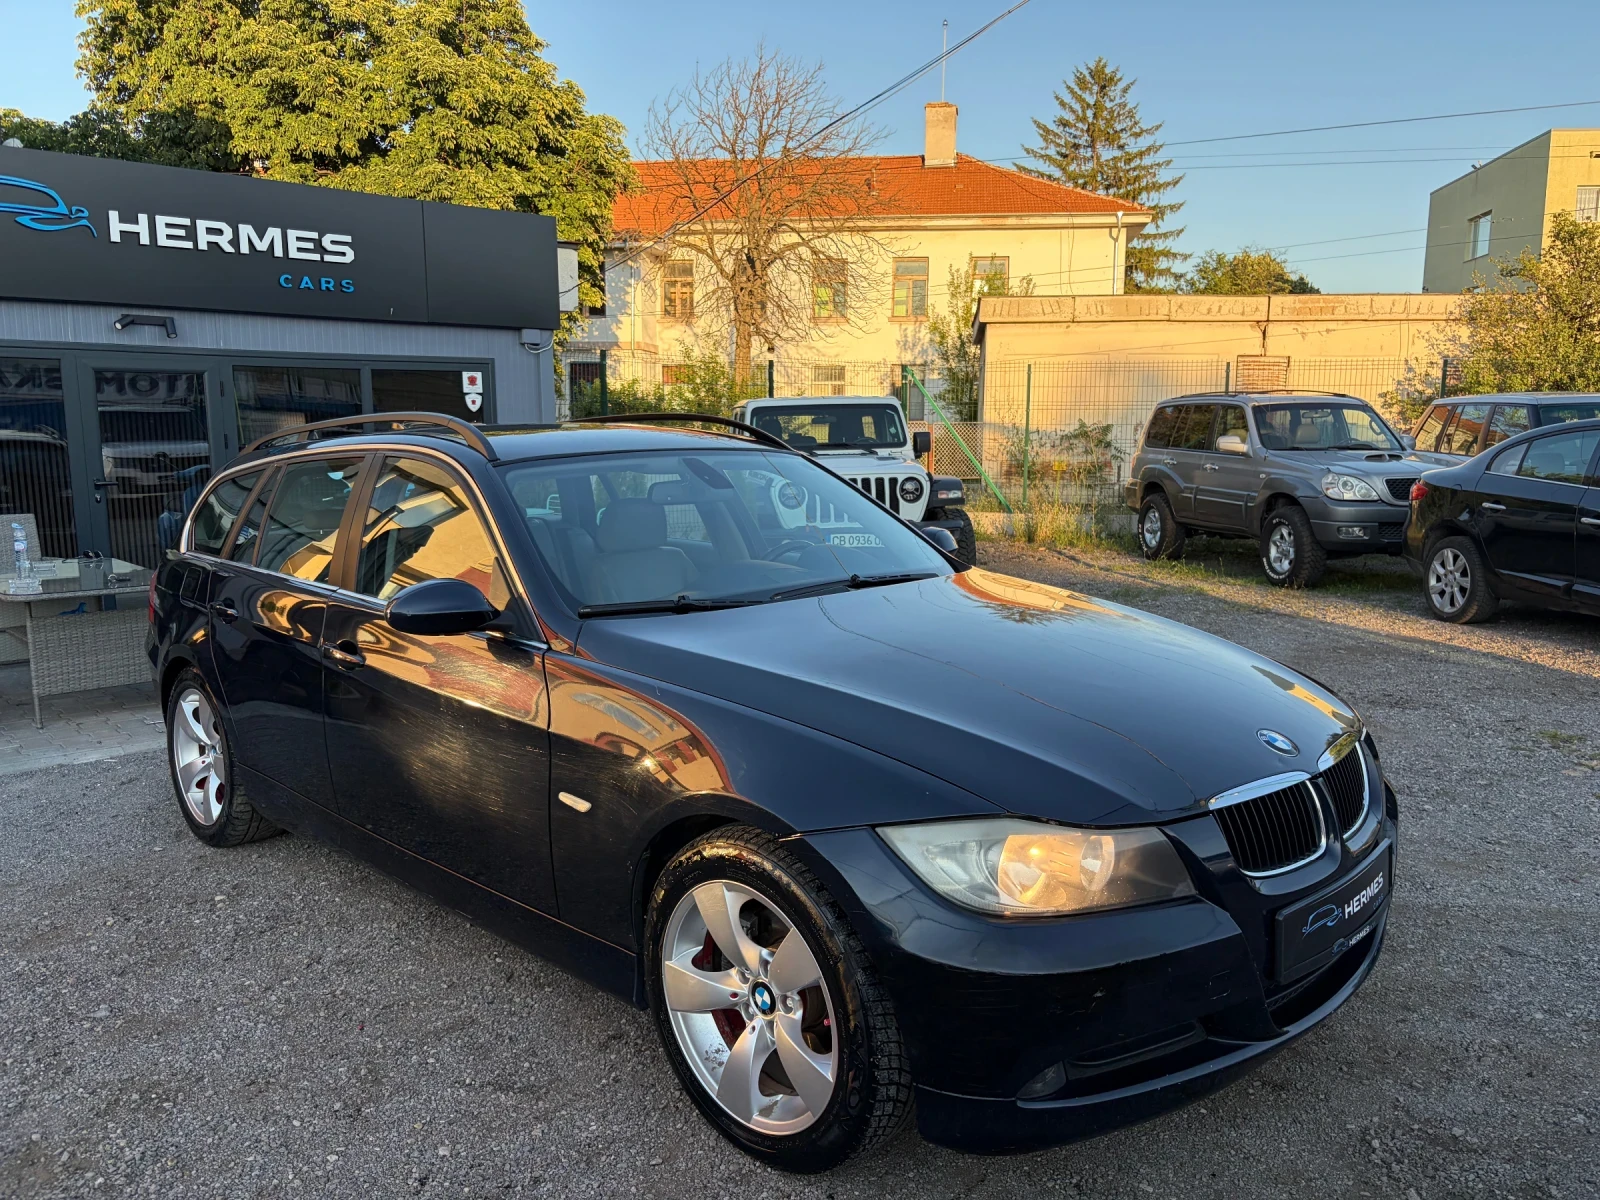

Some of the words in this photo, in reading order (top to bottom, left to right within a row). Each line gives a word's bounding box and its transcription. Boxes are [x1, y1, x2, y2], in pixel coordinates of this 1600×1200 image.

[108, 210, 355, 264] HERMES
[279, 274, 356, 293] CARS
[832, 536, 846, 546] CB
[848, 536, 873, 546] 0936
[1344, 872, 1383, 919] HERMES
[1349, 926, 1369, 946] HERMES
